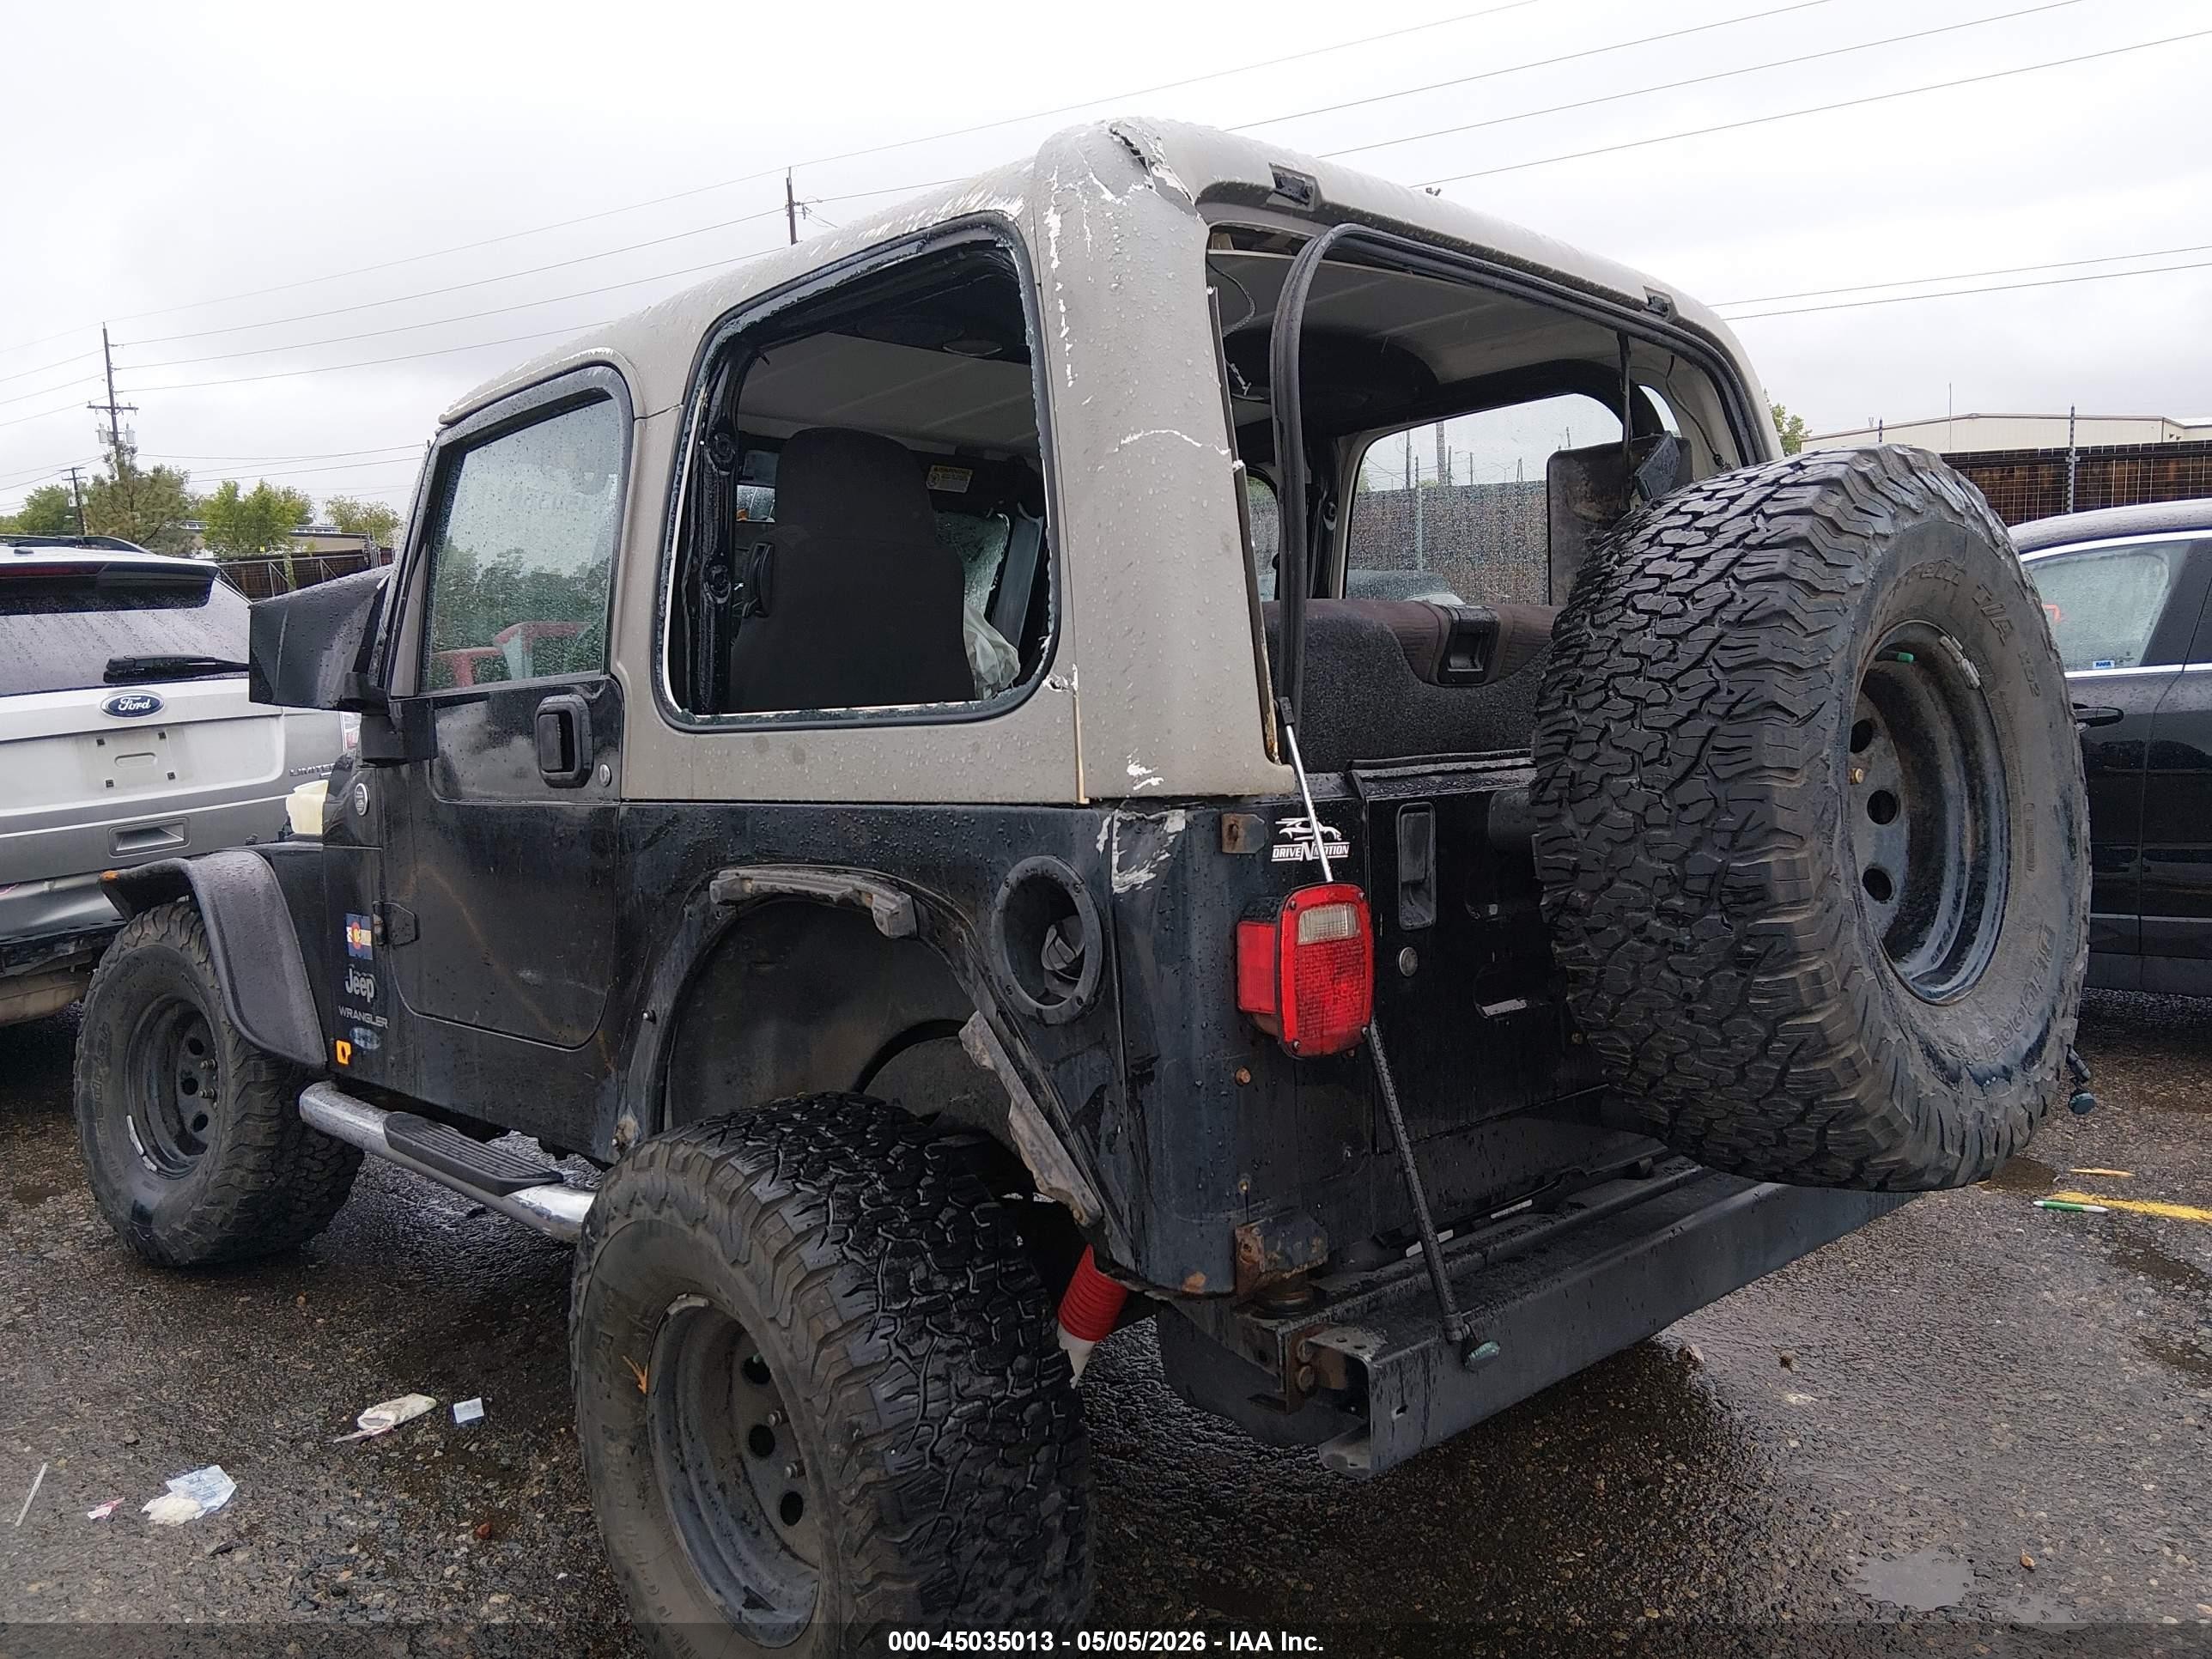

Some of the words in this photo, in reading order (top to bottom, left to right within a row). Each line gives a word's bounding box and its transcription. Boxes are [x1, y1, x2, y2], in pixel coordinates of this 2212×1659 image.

[118, 696, 152, 711] Ford
[345, 968, 374, 1002] Jeep
[338, 1006, 389, 1030] WRANGLER
